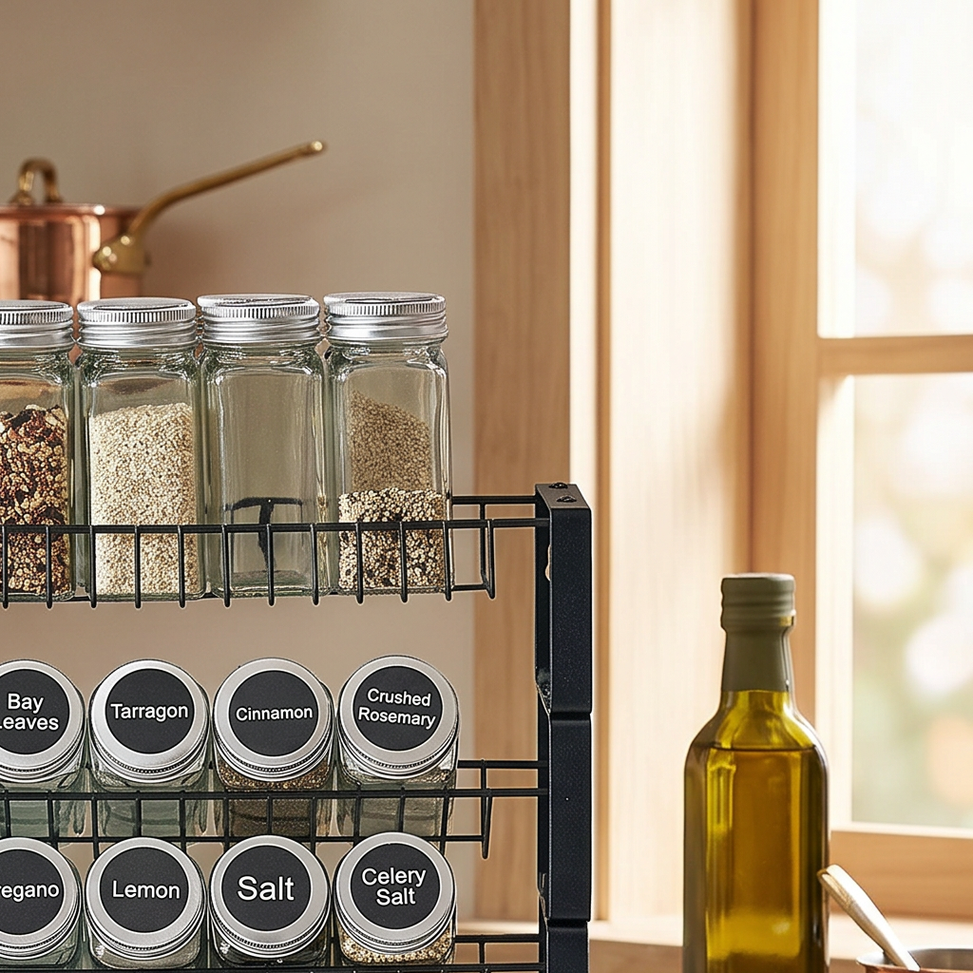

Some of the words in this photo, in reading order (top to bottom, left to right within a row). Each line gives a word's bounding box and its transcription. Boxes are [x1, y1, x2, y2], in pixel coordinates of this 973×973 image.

[7, 693, 44, 714] Bay
[367, 688, 431, 707] Crushed
[110, 703, 189, 722] Tarragon
[235, 707, 313, 721] Cinnamon
[358, 706, 436, 730] Rosemary
[361, 867, 427, 888] Celery
[112, 880, 180, 899] Lemon
[237, 875, 295, 901] Salt
[376, 887, 416, 906] Salt
